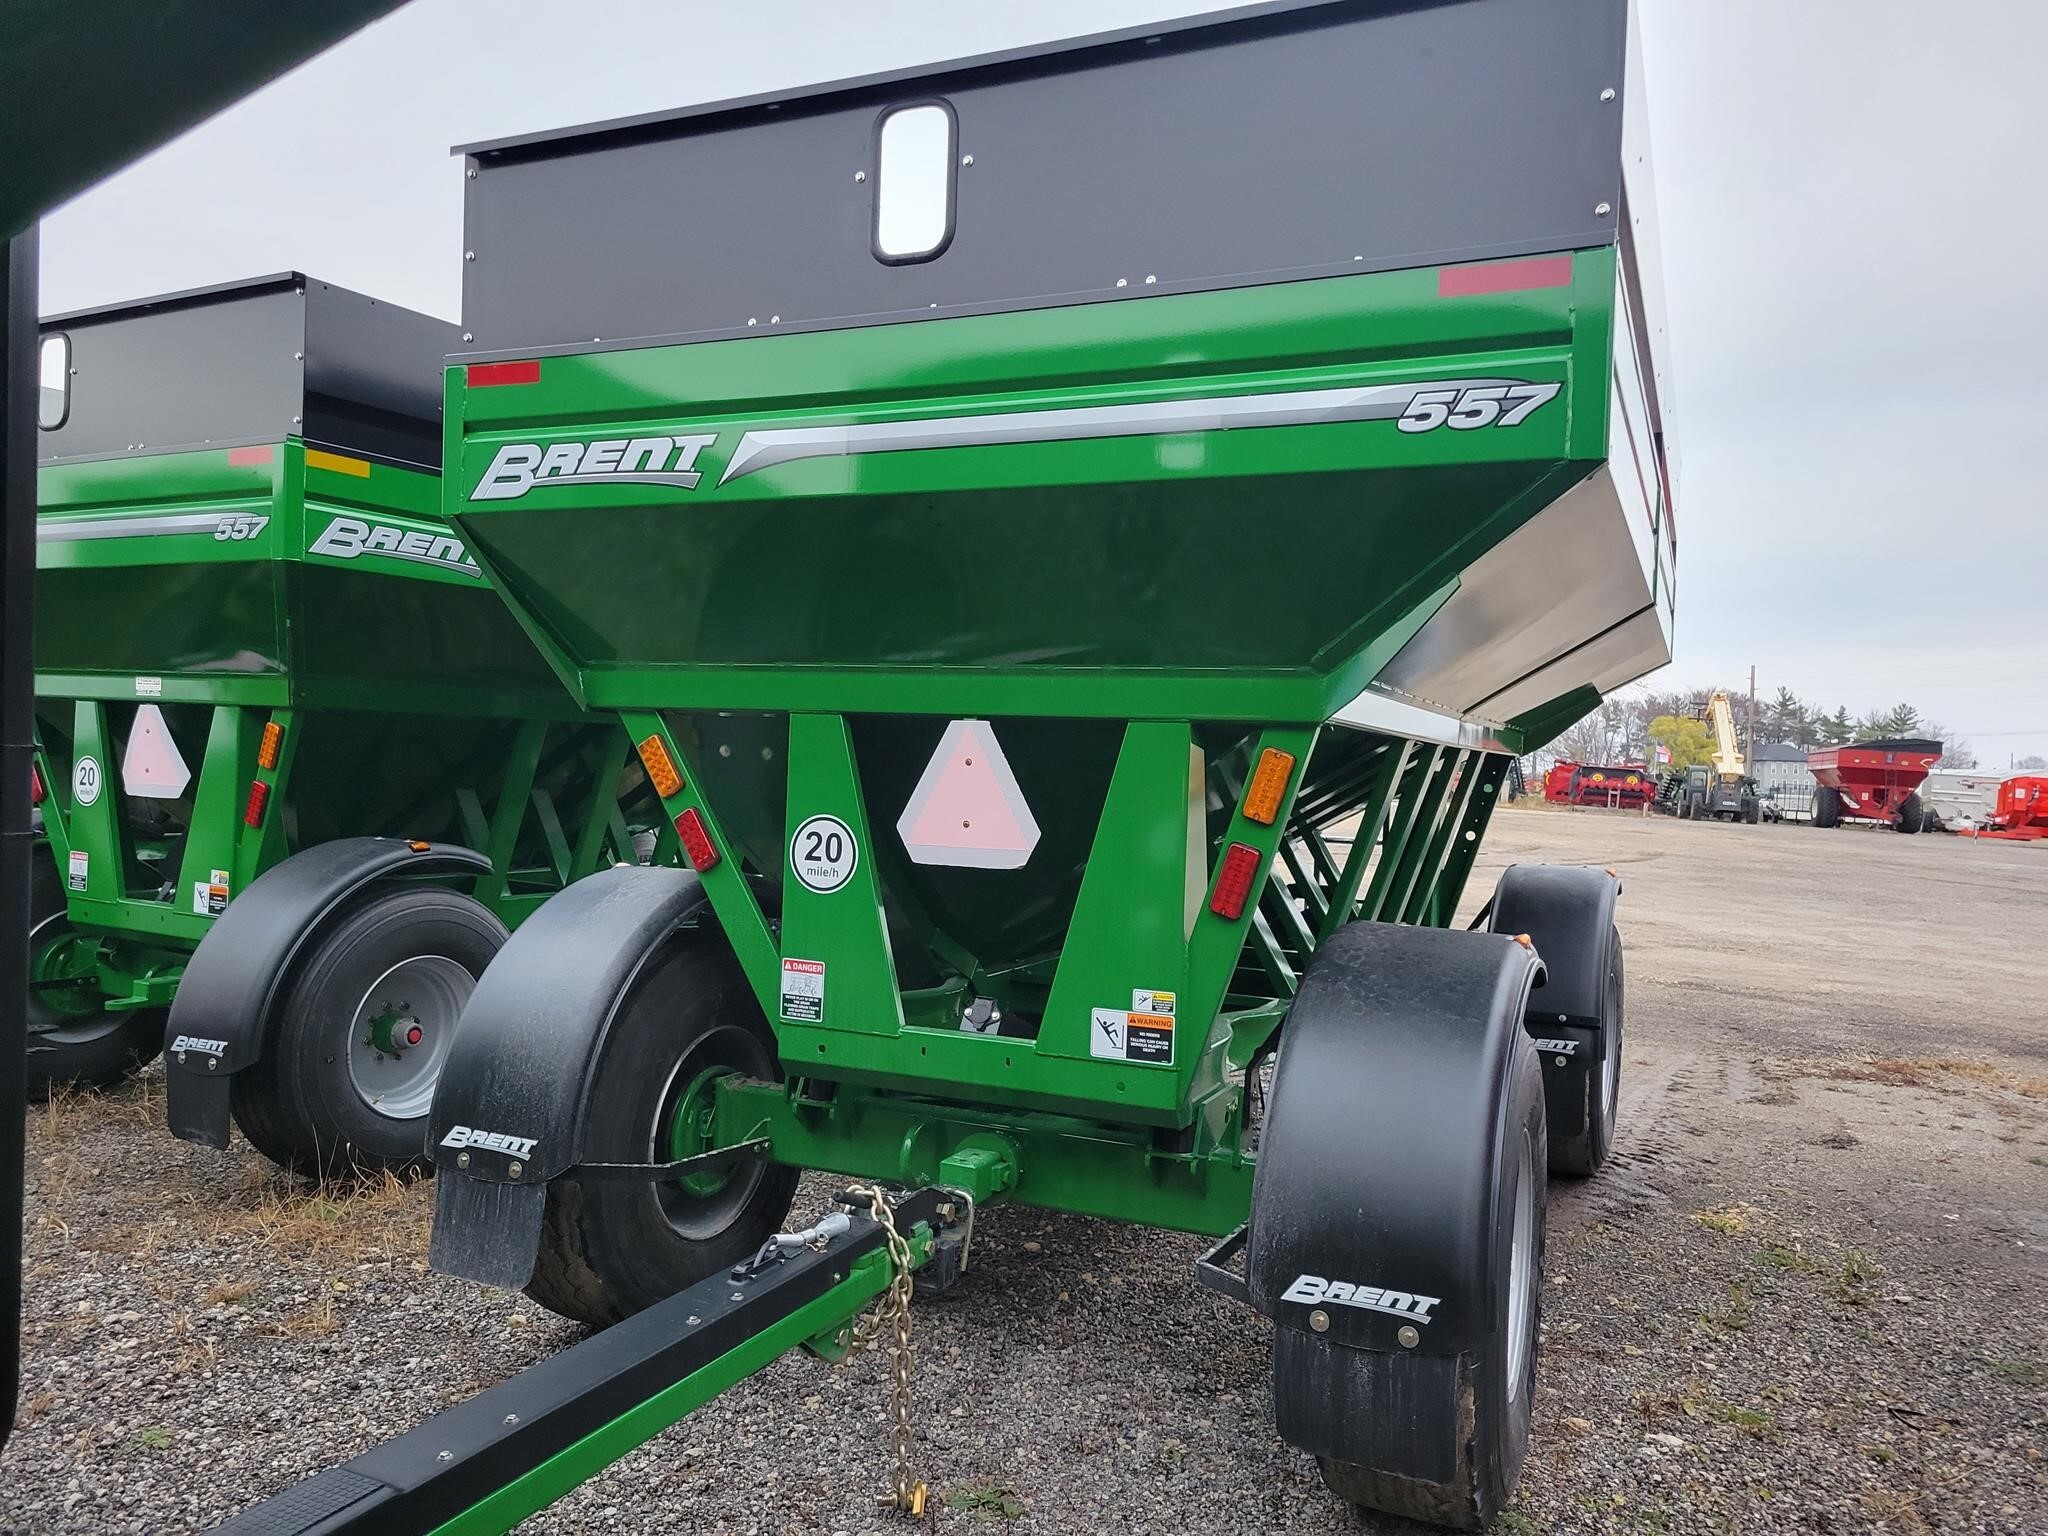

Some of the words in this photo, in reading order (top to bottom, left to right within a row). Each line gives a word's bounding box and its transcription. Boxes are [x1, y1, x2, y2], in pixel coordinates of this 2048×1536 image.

[1397, 382, 1563, 434] 557
[468, 433, 719, 500] BRENT
[213, 516, 270, 541] 557
[308, 517, 481, 568] BREN
[79, 766, 95, 787] 20
[804, 831, 843, 864] 20
[806, 866, 839, 878] mile/h
[792, 962, 823, 973] DANGER
[1136, 1017, 1172, 1028] WARNING
[170, 1035, 228, 1055] BRENT
[440, 1125, 539, 1156] BRENT
[1279, 1274, 1441, 1320] BRENT
